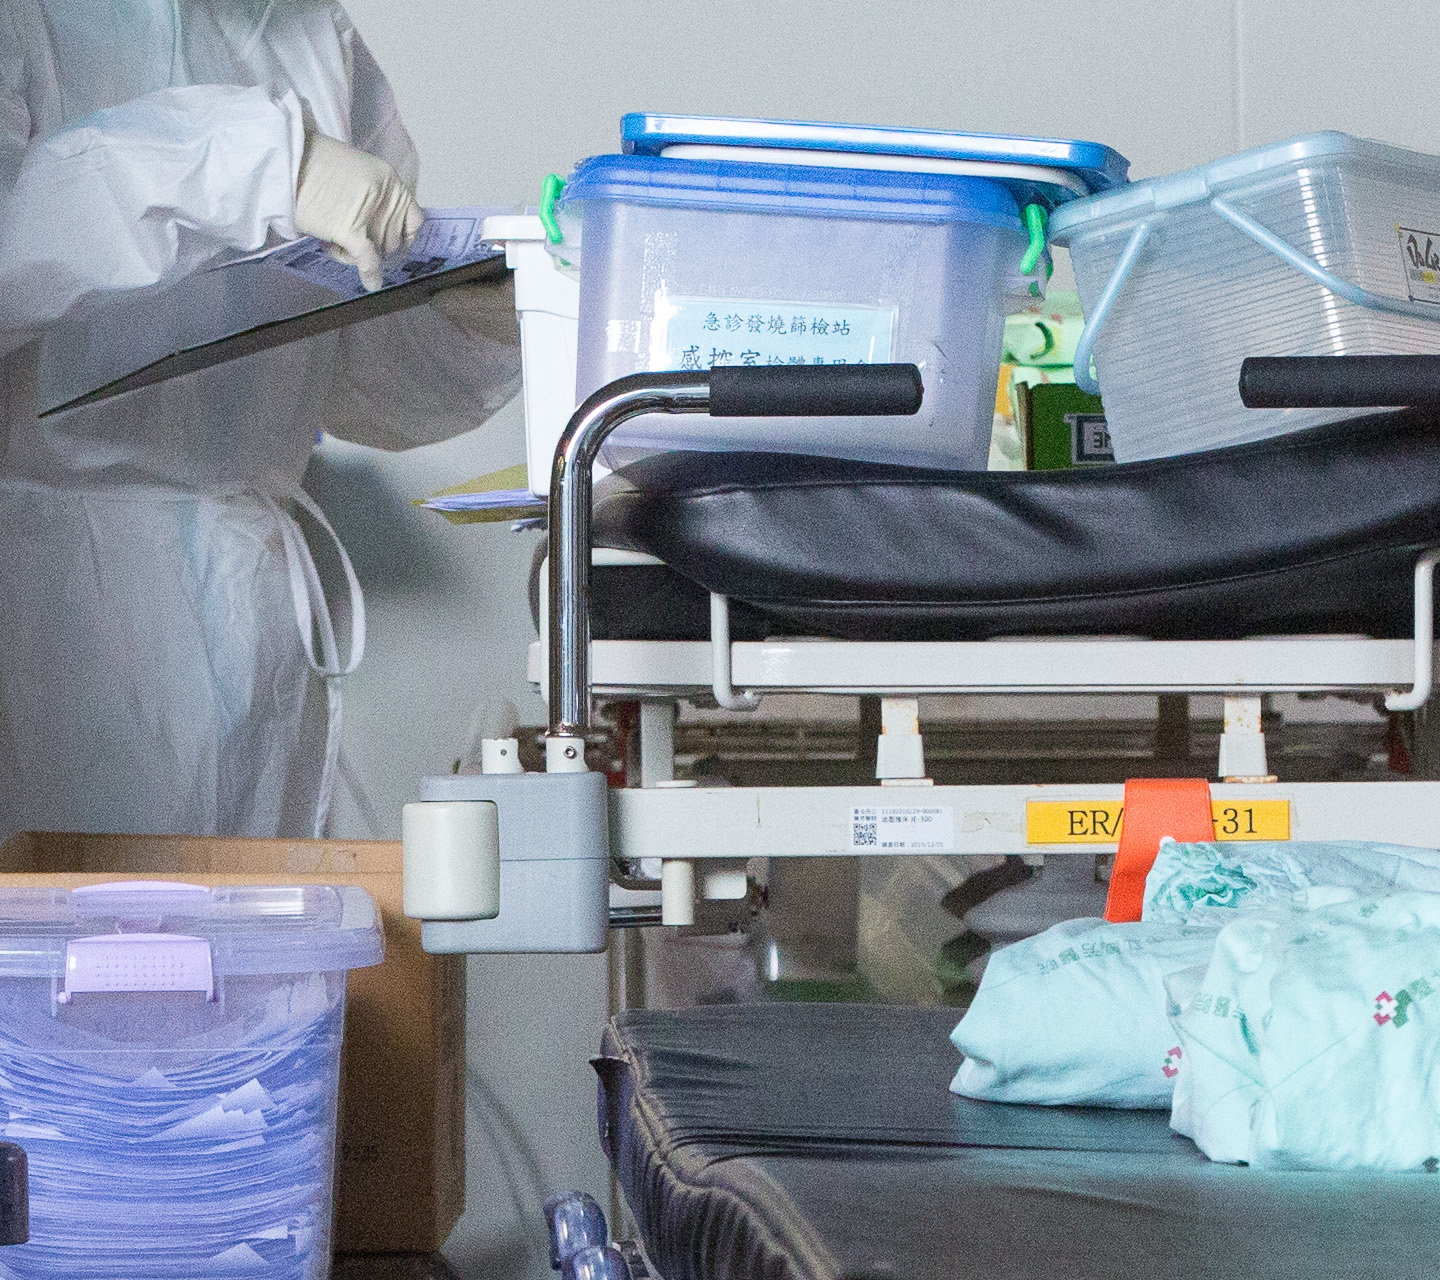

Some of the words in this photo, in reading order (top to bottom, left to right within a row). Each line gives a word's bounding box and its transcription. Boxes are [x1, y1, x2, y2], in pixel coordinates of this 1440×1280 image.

[702, 310, 851, 336] 急診發燒篩檢站
